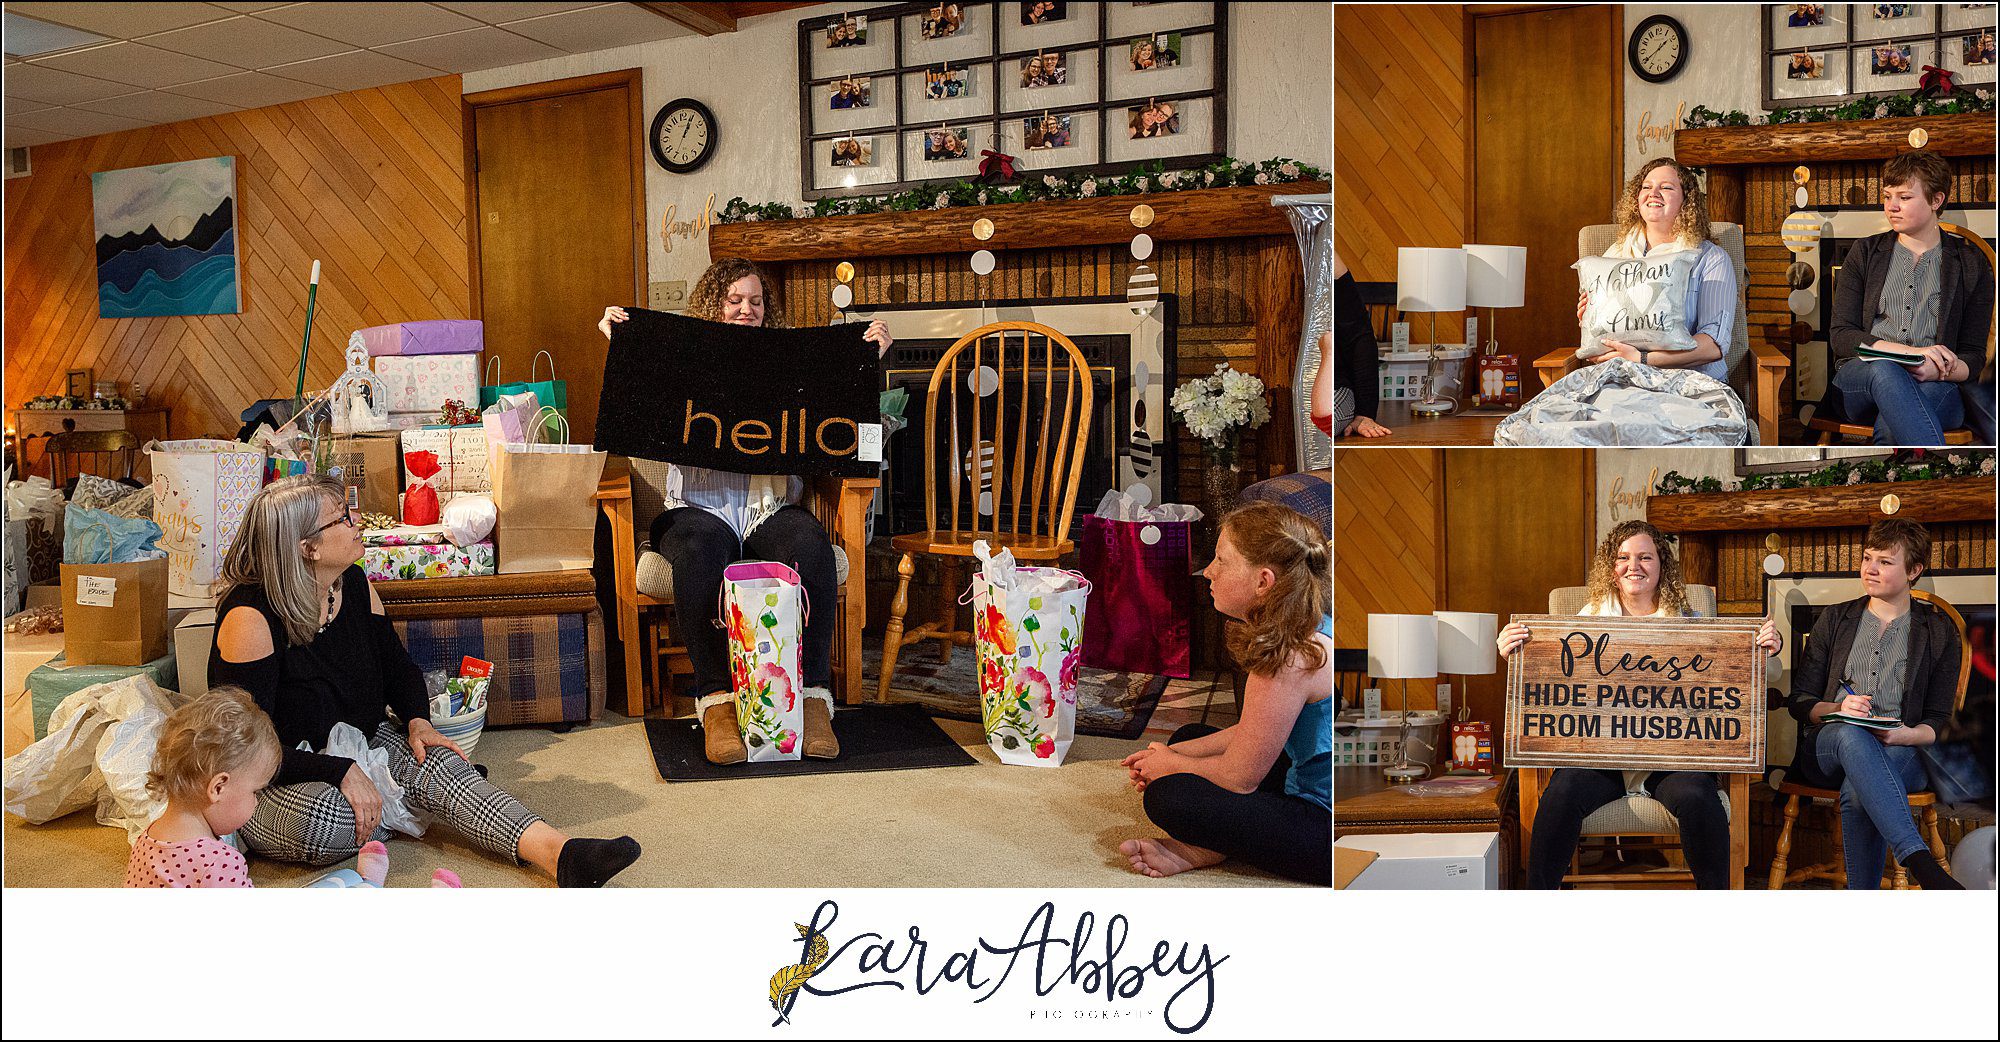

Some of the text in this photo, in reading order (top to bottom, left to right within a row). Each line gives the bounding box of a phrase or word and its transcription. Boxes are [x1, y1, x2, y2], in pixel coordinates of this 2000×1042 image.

[1637, 100, 1686, 155] famil
[662, 192, 716, 253] famil
[1588, 262, 1674, 297] Nathan
[683, 400, 858, 456] hello
[342, 465, 365, 477] GILE
[1608, 467, 1658, 521] famil
[169, 552, 199, 571] ever
[1560, 631, 1713, 681] Please
[1524, 683, 1742, 710] HIDE PACKAGES
[1523, 714, 1741, 740] FROM HUSBAND
